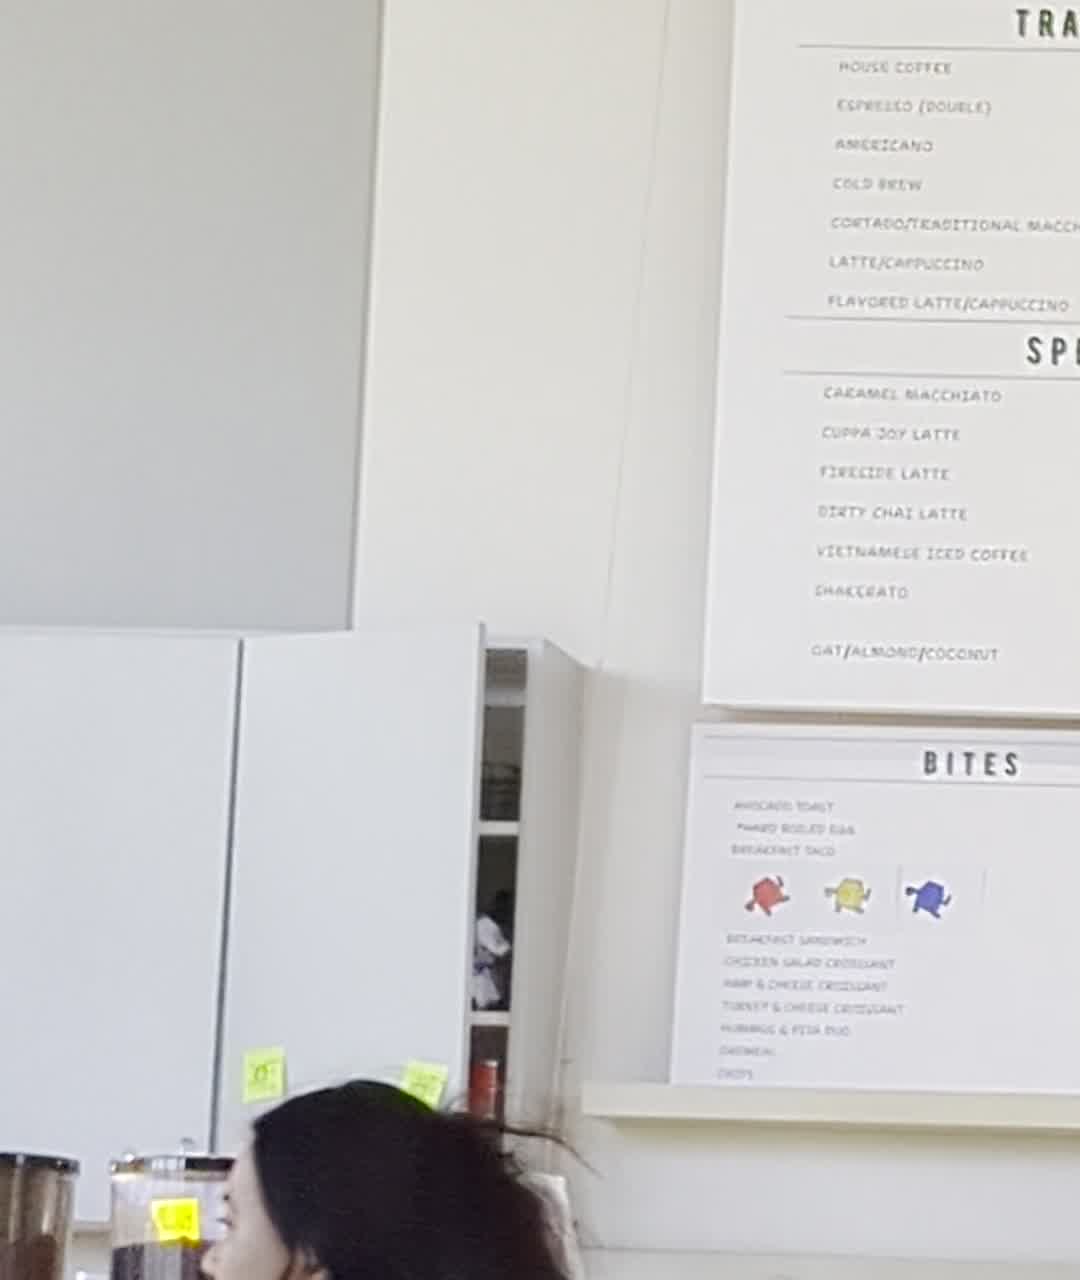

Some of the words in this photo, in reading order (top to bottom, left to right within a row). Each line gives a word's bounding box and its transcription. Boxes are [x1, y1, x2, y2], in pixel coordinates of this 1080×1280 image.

[839, 61, 888, 74] HOUSE
[895, 62, 952, 75] COFFEE
[836, 99, 912, 113] ESPRESSO
[918, 99, 993, 117] (DOUBLE)
[835, 139, 933, 152] AMERICANO
[832, 177, 872, 191] COLD
[878, 178, 922, 192] BREW
[831, 217, 1020, 233] CORTADO/TRADITIONAL
[829, 256, 984, 272] LATTE/CAPPUCCINO
[828, 296, 908, 310] FLAVORED
[913, 297, 1069, 312] LATTE/CAPPUCCINO
[824, 386, 898, 401] CARAMEL
[905, 389, 1002, 403] MACCHIATO
[822, 426, 870, 439] CUPPA
[876, 427, 907, 440] JOY
[912, 428, 960, 441] LATTE
[901, 467, 949, 480] LATTE
[818, 505, 866, 518] DIRTY
[872, 506, 912, 520] CHAI
[919, 507, 967, 521] LATTE
[817, 544, 920, 560] VIETNAMESE
[927, 547, 965, 560] ICED
[969, 548, 1028, 562] COFFEE
[811, 645, 999, 663] OAT/ALMOND/COCONUT
[922, 749, 1020, 777] BITES
